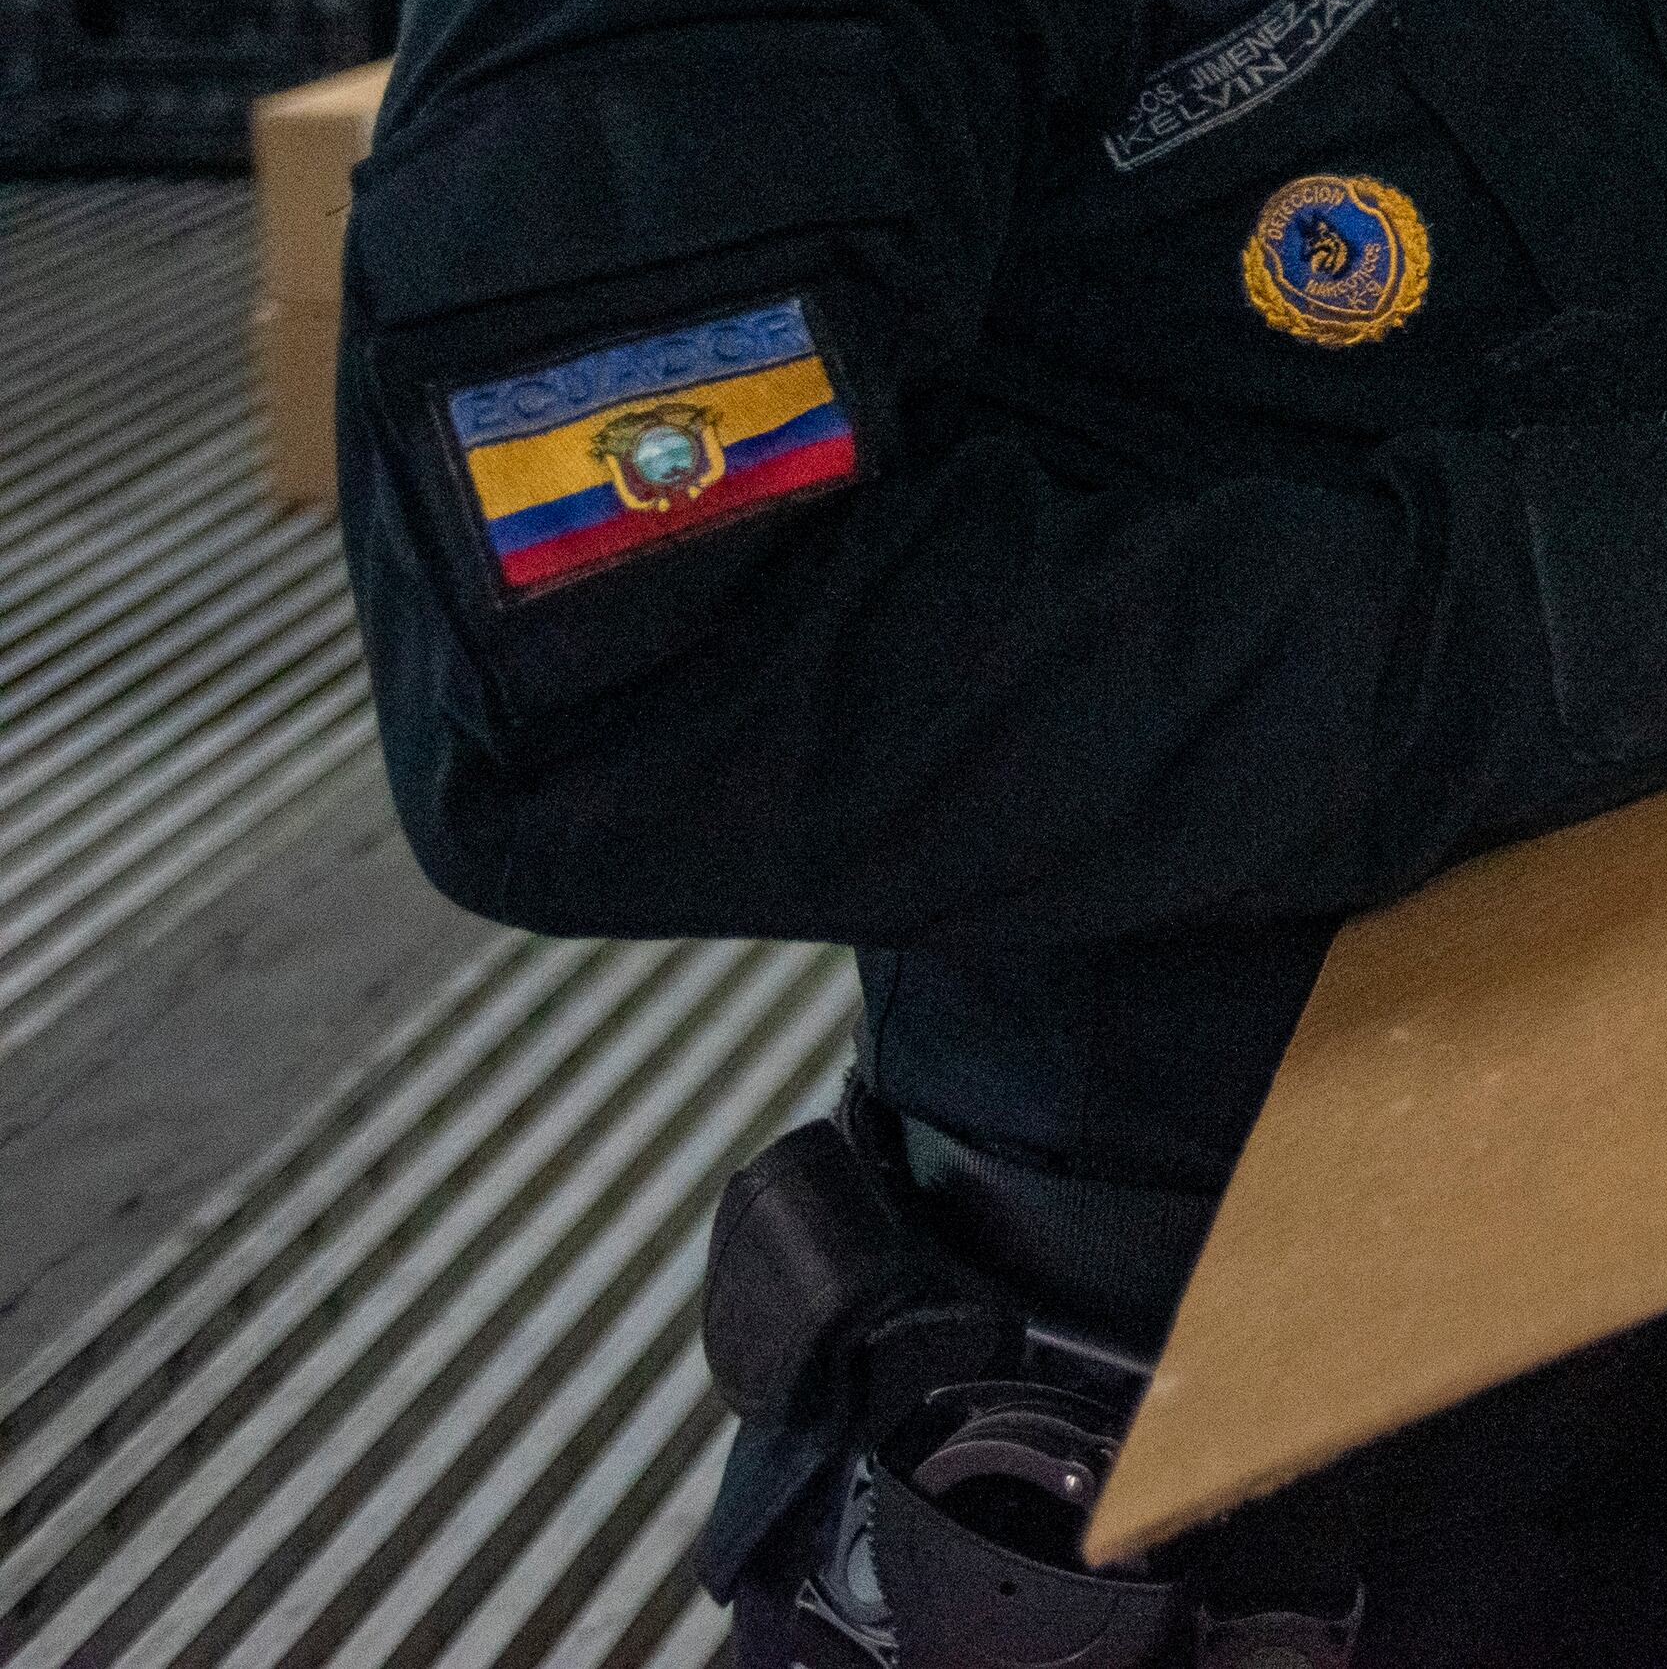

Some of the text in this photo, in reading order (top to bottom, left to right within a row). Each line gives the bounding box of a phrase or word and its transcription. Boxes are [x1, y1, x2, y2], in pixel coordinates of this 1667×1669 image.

[1188, 2, 1297, 91] JIMENEZ
[1116, 53, 1287, 154] KELVIN
[1268, 186, 1345, 241] DETECCION
[472, 312, 802, 430] ECUADOR
